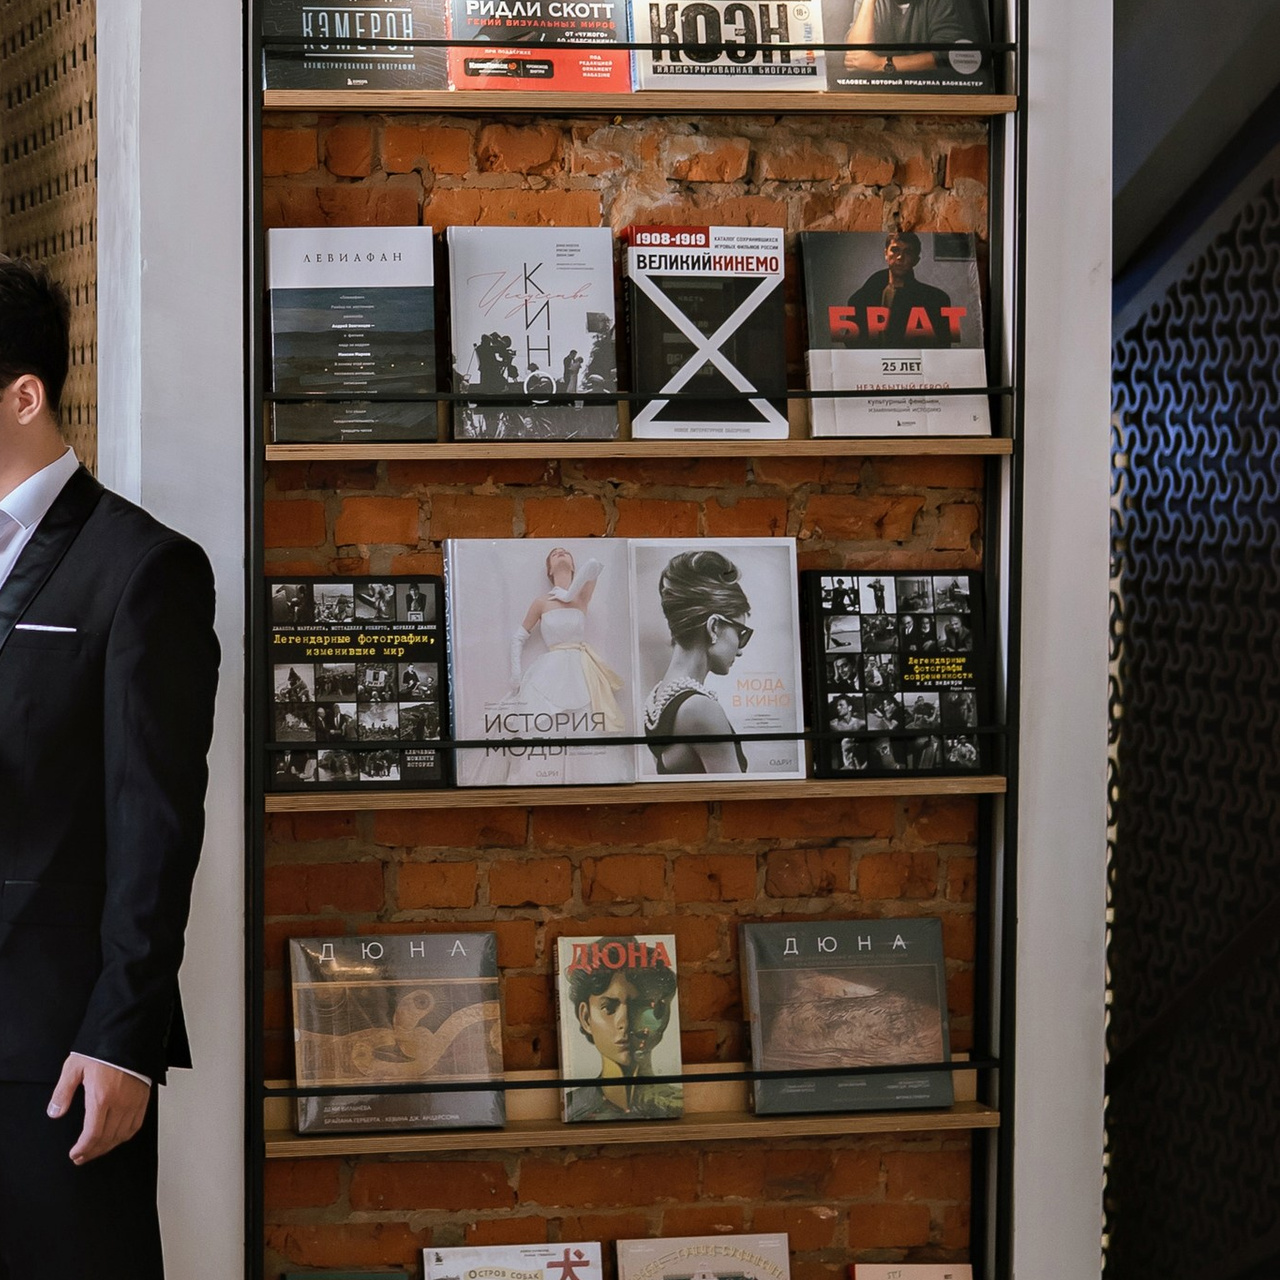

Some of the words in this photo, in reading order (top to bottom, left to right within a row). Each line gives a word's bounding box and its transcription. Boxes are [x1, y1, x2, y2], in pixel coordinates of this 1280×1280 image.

[465, 0, 541, 18] РИДЛИ
[548, 2, 615, 19] СКОТТ
[466, 17, 502, 26] ГЕНИЙ
[505, 19, 576, 28] ВИЗУАЛЬНЫХ
[580, 21, 616, 29] МИРОВ
[302, 12, 414, 51] КЭМЕРОН
[648, 2, 791, 64] КОЭН
[655, 65, 754, 75] ИЛЛЮСТРИРОВАННАЯ
[758, 66, 812, 74] БИОГРАФИЯ
[836, 78, 870, 86] ЧЕЛОВЕК,
[635, 232, 706, 245] 1908-1919
[302, 252, 403, 263] ЛЕВИАФАН
[828, 305, 967, 341] БРАТ
[882, 362, 897, 372] 25
[899, 362, 922, 372] ЛЕТ
[867, 399, 907, 407] культурный
[273, 634, 351, 645] Легендарные
[357, 633, 436, 645] фотографии,
[306, 648, 376, 656] изменившие
[383, 648, 405, 657] мир
[908, 656, 967, 665] Легендарные
[913, 663, 963, 673] фотографы
[903, 672, 973, 681] современности
[736, 678, 785, 693] МОДА
[732, 695, 742, 707] В
[745, 694, 791, 708] КИНО
[484, 712, 606, 734] ИСТОРИЯ
[485, 736, 568, 760] МОДЫ
[783, 934, 907, 955] ДЮНА
[319, 939, 467, 964] ДЮНА
[567, 941, 672, 975] ДЮНА
